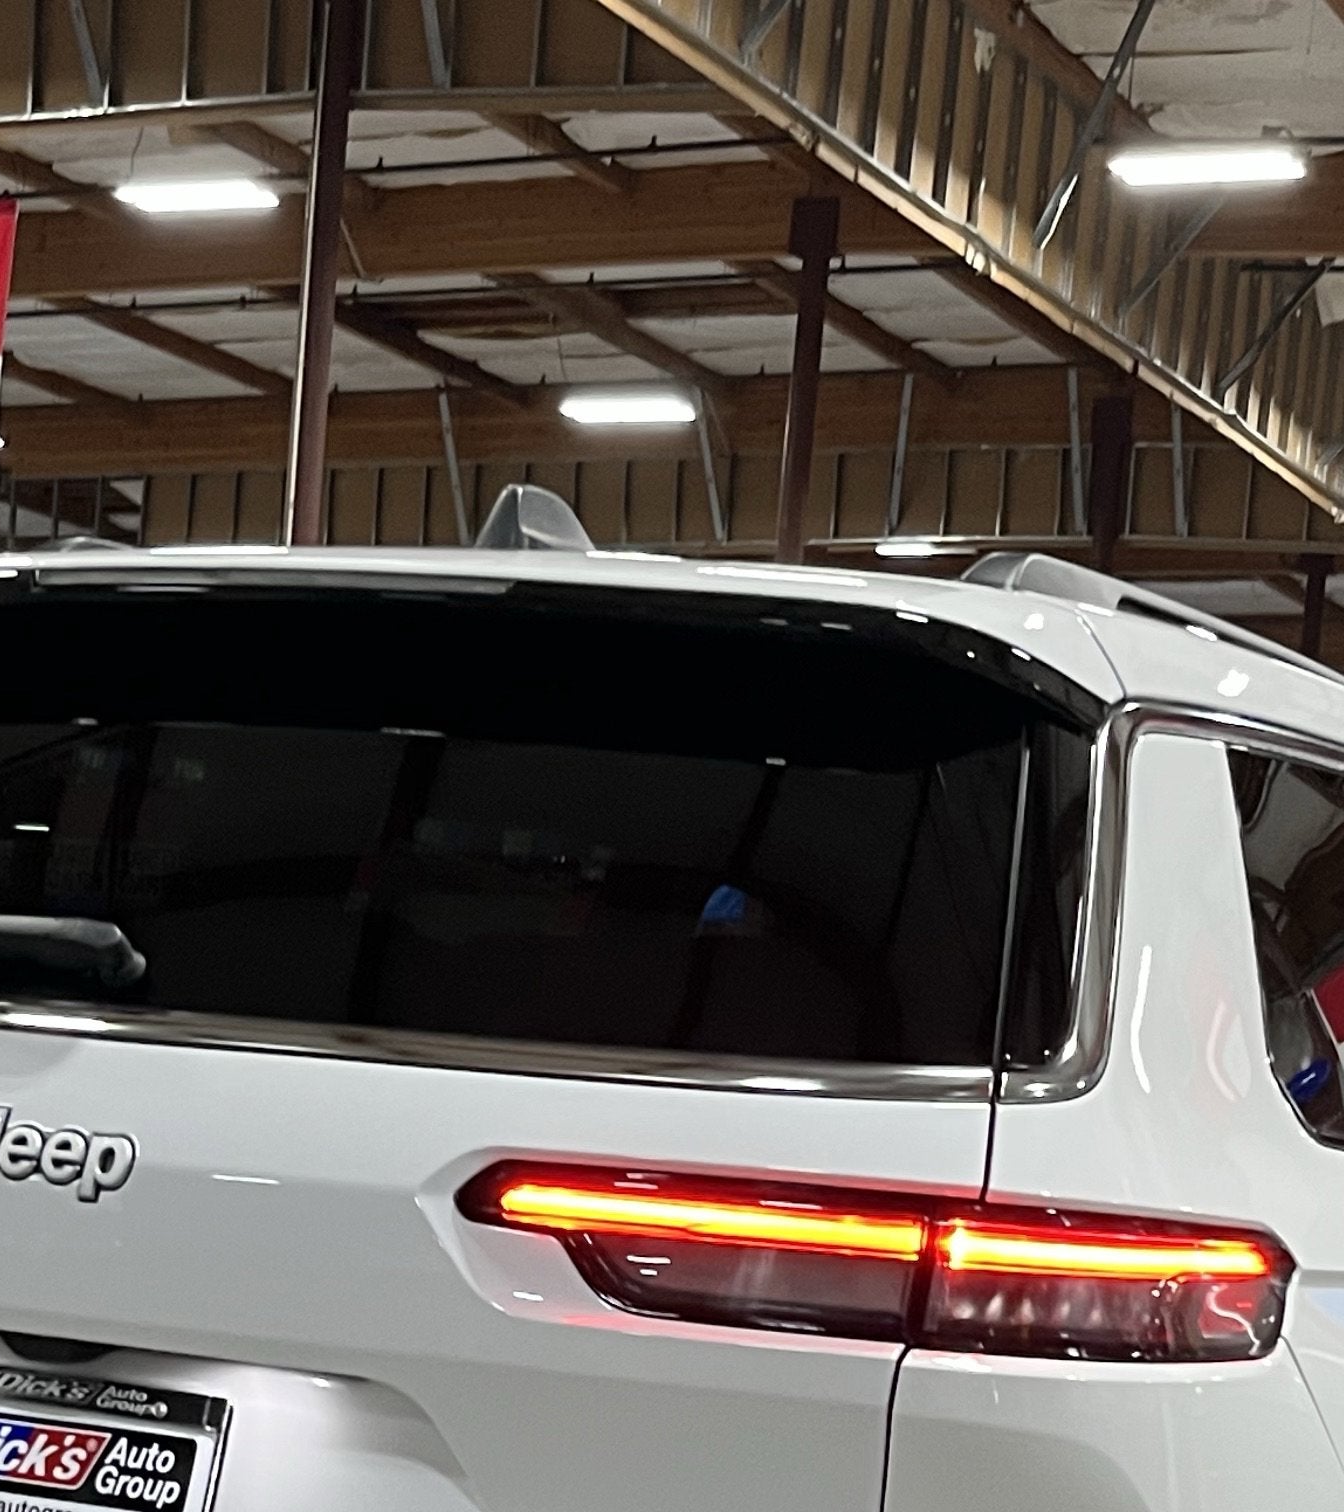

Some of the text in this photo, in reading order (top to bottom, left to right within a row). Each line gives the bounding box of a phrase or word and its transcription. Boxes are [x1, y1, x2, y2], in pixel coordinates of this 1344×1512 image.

[102, 1385, 148, 1402] Auto
[104, 1437, 176, 1474] Auto
[94, 1465, 181, 1510] Group
